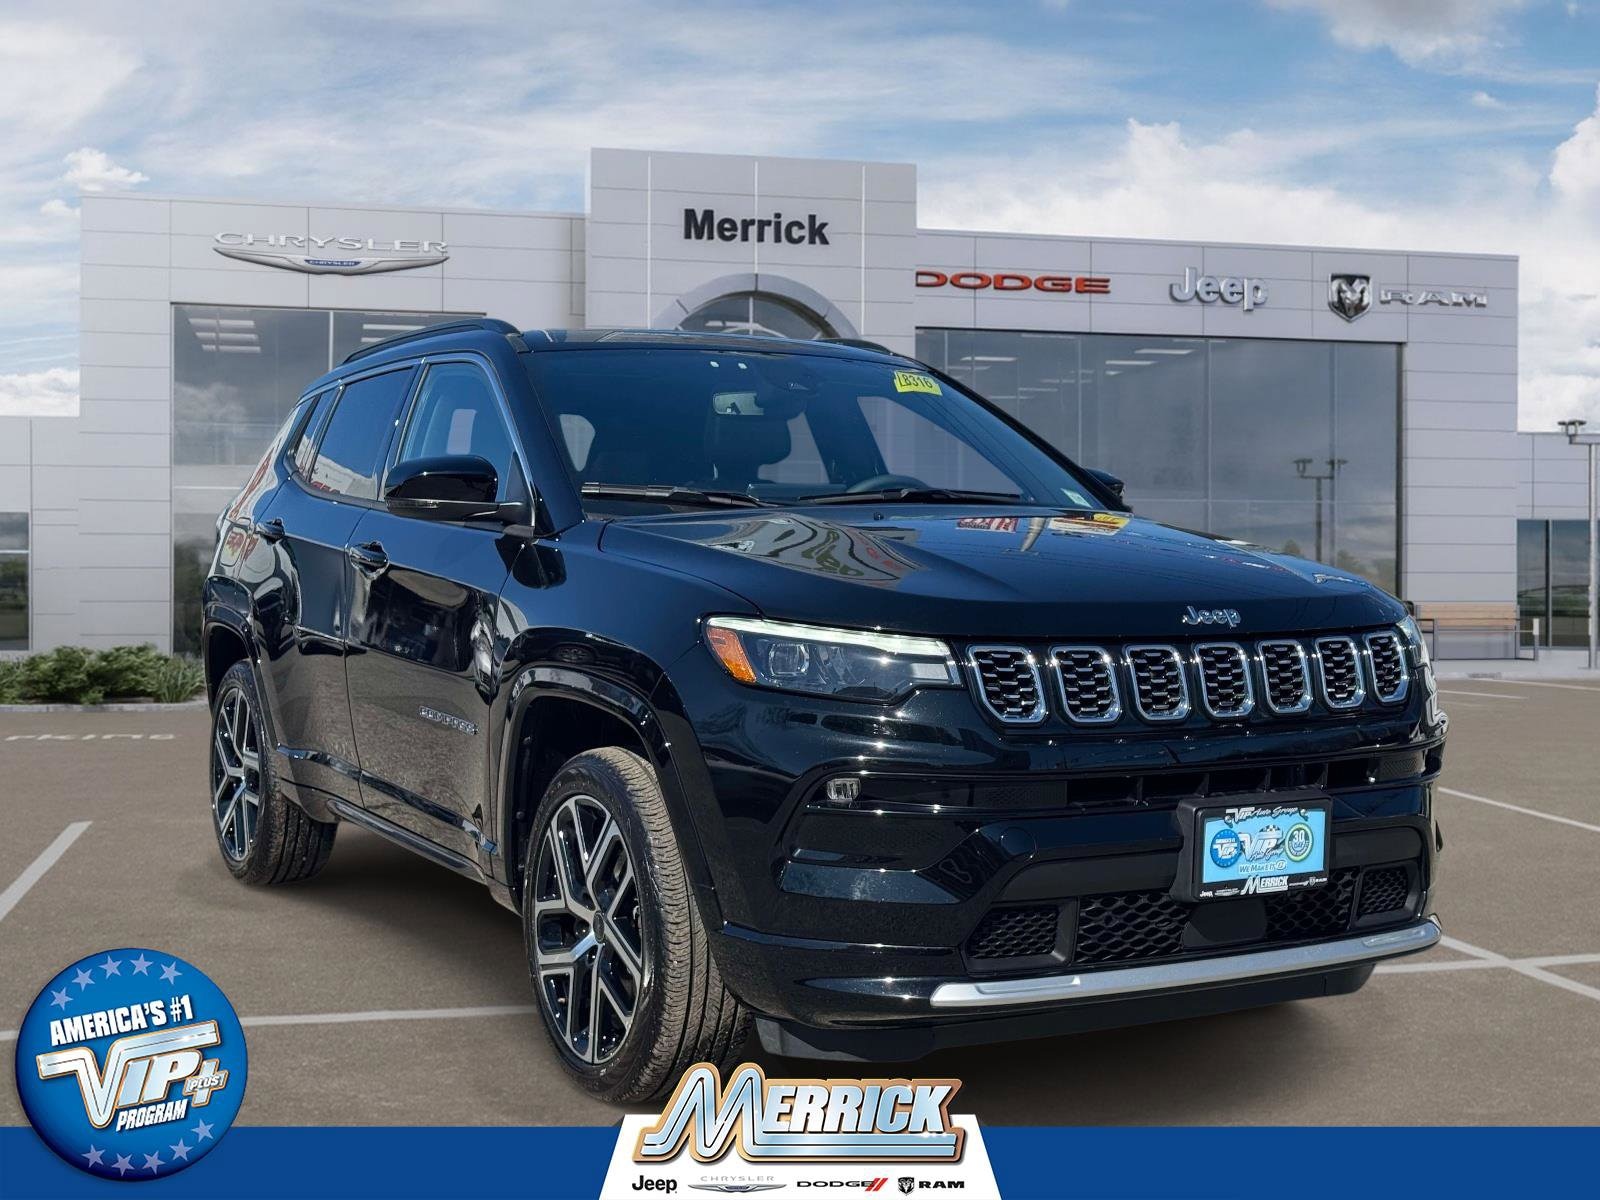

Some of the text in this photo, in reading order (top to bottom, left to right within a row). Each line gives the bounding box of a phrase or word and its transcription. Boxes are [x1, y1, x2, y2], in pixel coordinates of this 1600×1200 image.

[683, 208, 830, 245] Merrick
[214, 231, 449, 253] CHRYSLER
[915, 270, 1111, 294] DODGE
[1169, 266, 1268, 311] Jeep
[1380, 289, 1488, 308] RAM
[1182, 605, 1242, 628] Jeep
[1293, 830, 1305, 842] 30
[1240, 876, 1288, 895] MERRICK
